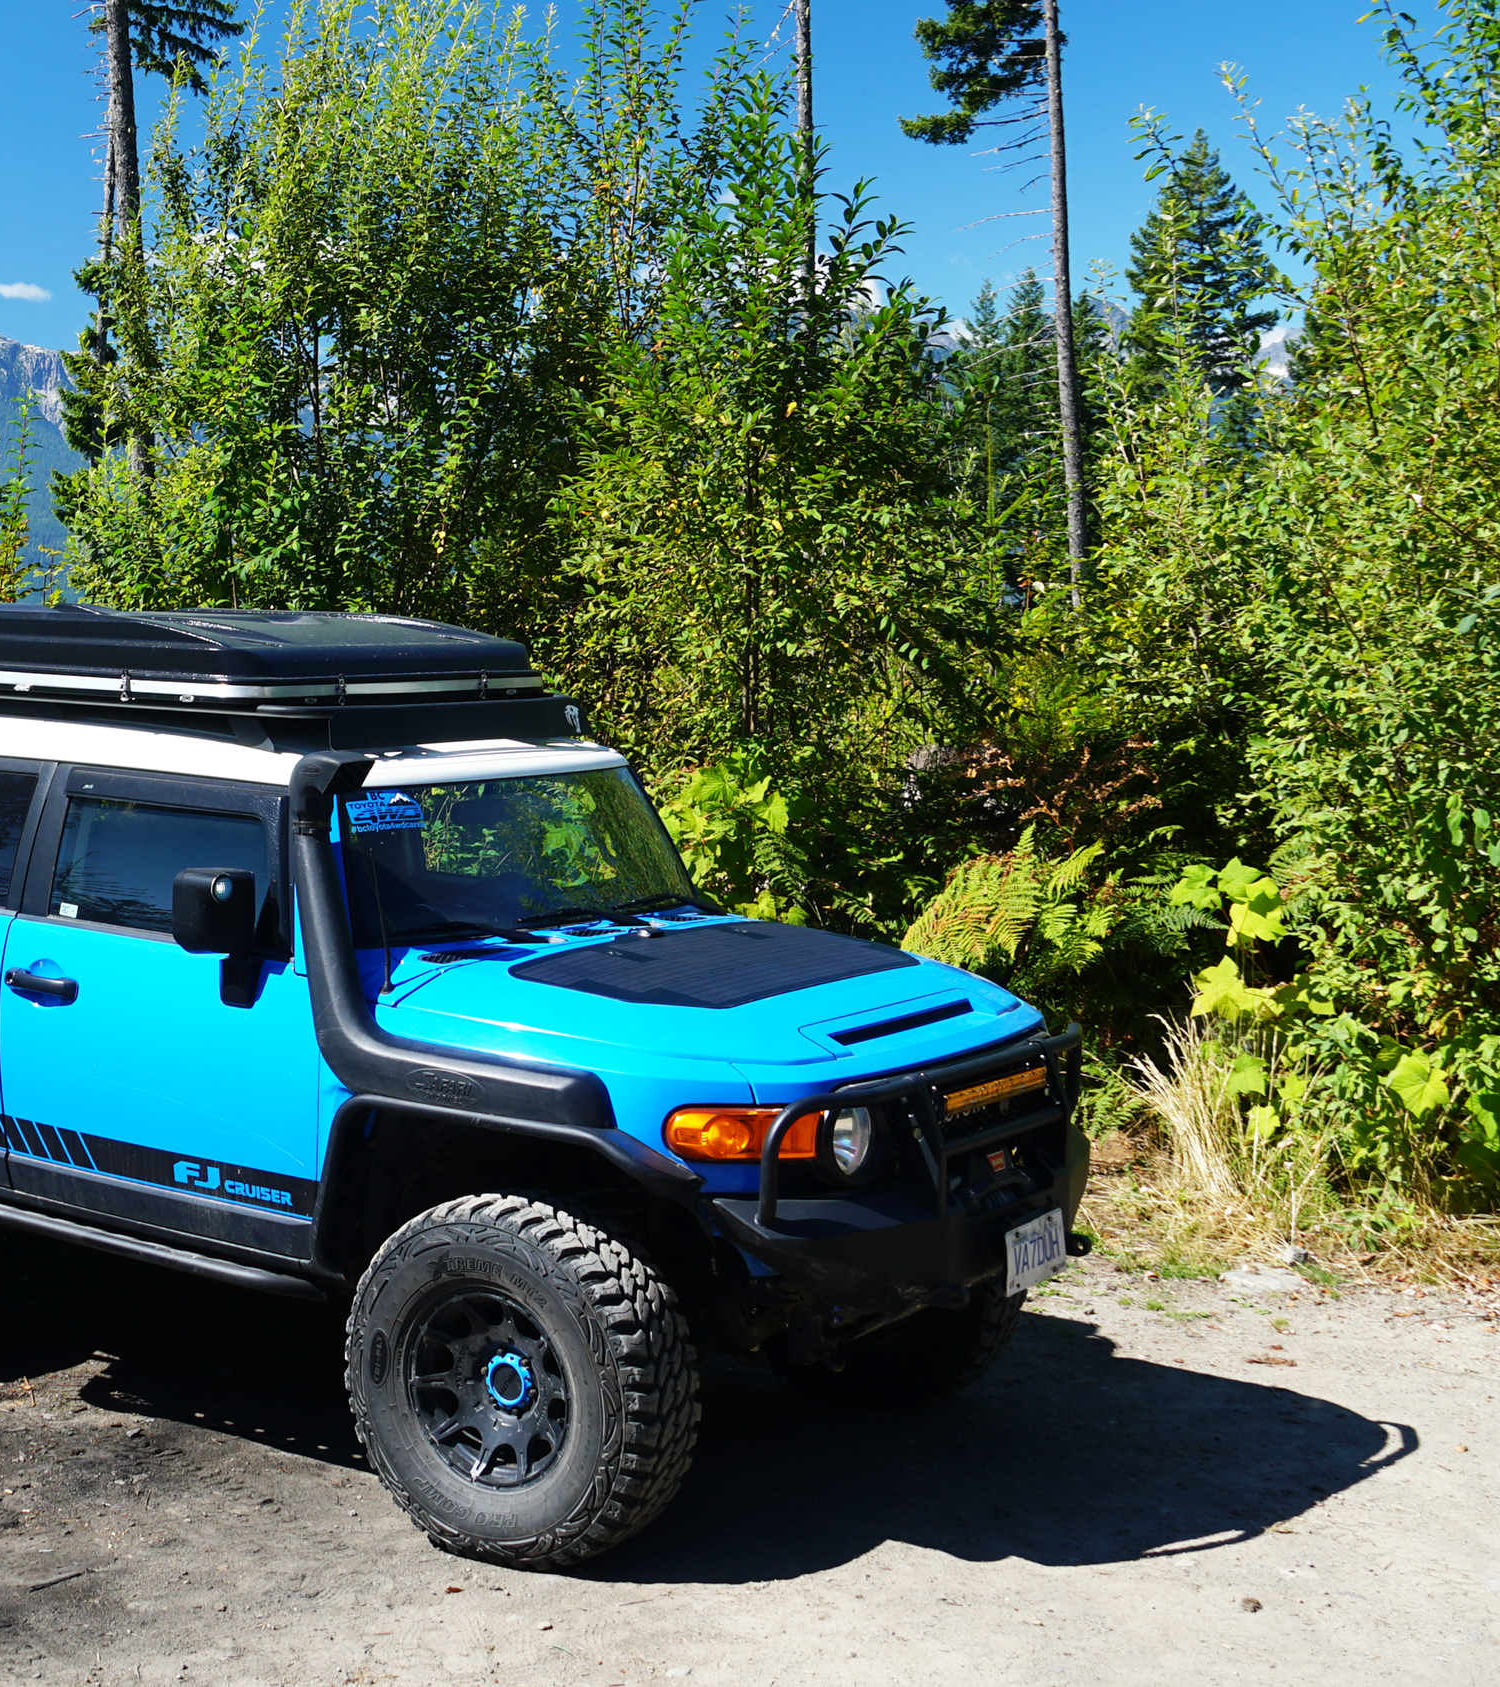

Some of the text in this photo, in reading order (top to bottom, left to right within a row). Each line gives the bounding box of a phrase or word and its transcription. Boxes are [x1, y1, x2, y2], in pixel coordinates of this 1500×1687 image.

[348, 801, 386, 810] TOYOTA
[353, 807, 421, 824] 4WD
[369, 791, 385, 801] BC
[415, 1071, 473, 1097] SAFARI
[173, 1160, 294, 1207] FJ CRUISER
[1012, 1227, 1060, 1276] VA7DUH
[426, 1249, 548, 1309] XTREME MT2
[373, 1333, 383, 1382] TRI-PLY
[413, 1476, 519, 1529] PRO COMP
